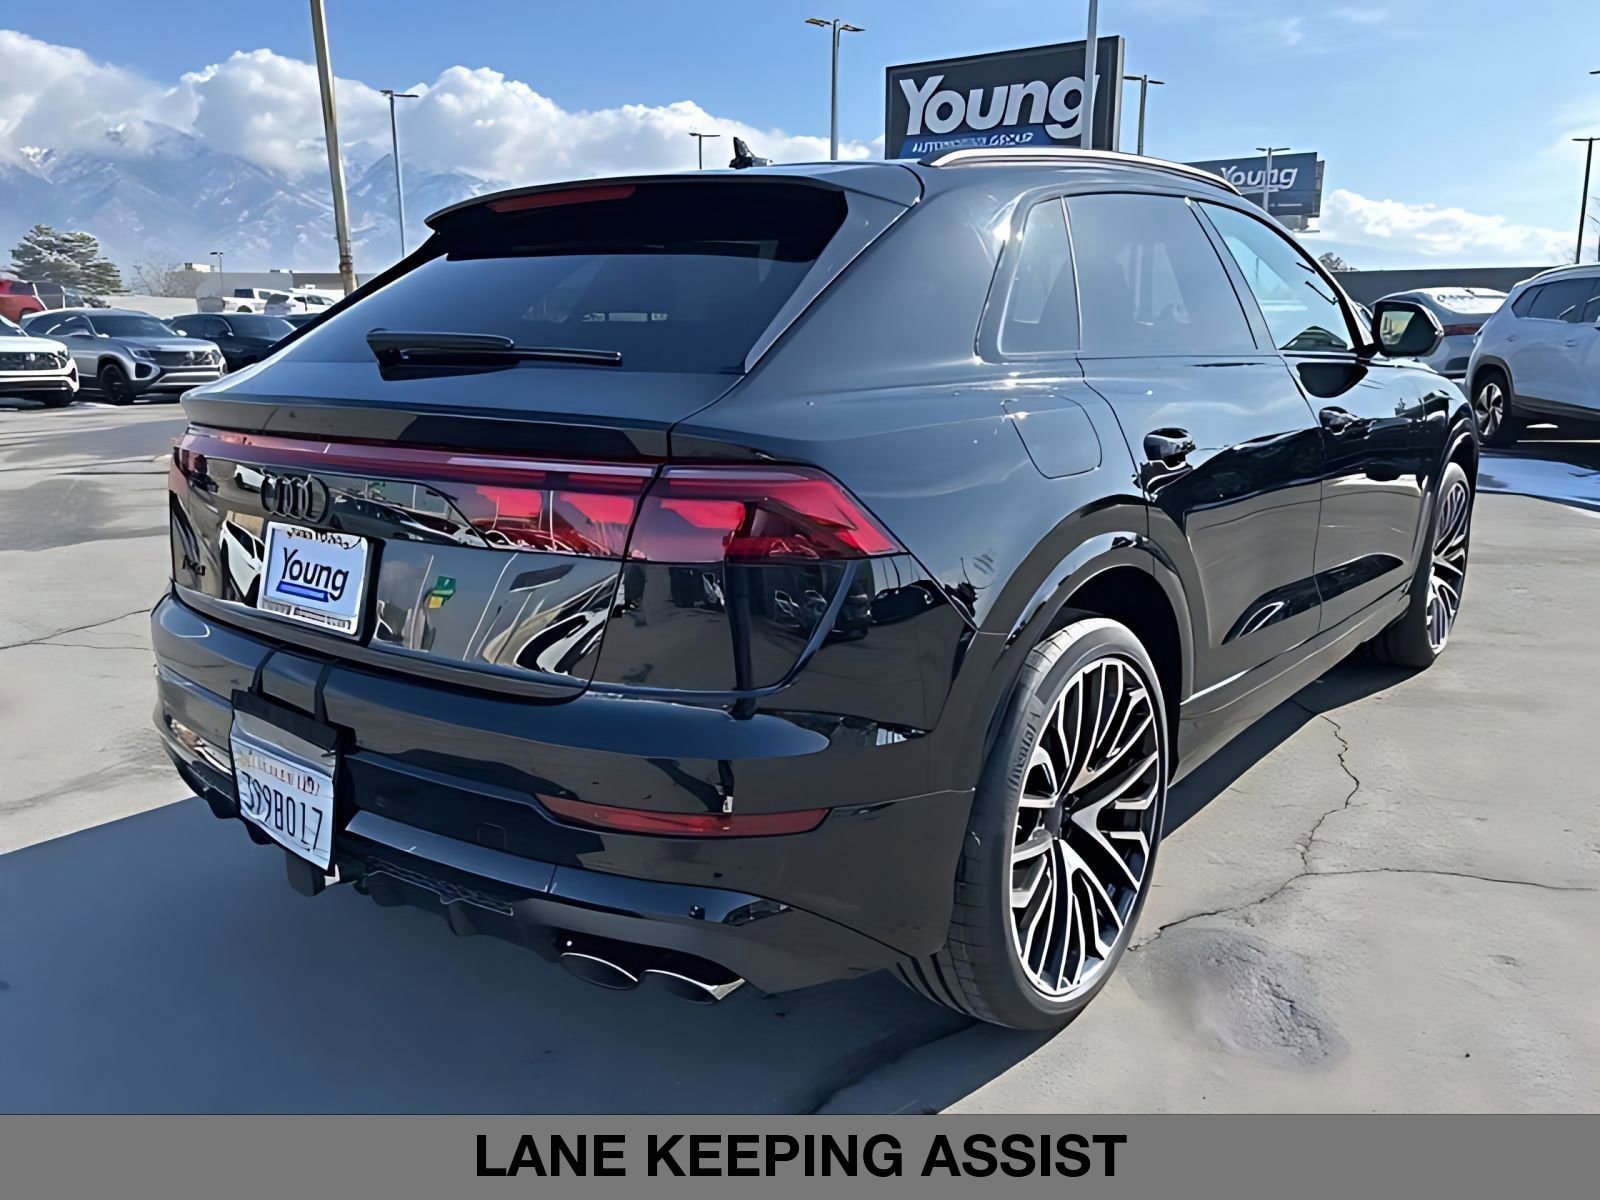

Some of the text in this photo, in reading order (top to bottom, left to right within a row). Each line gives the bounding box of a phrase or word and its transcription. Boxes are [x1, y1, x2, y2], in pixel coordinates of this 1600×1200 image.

[899, 74, 1100, 140] Young
[1220, 165, 1299, 190] Young
[281, 546, 350, 602] Young
